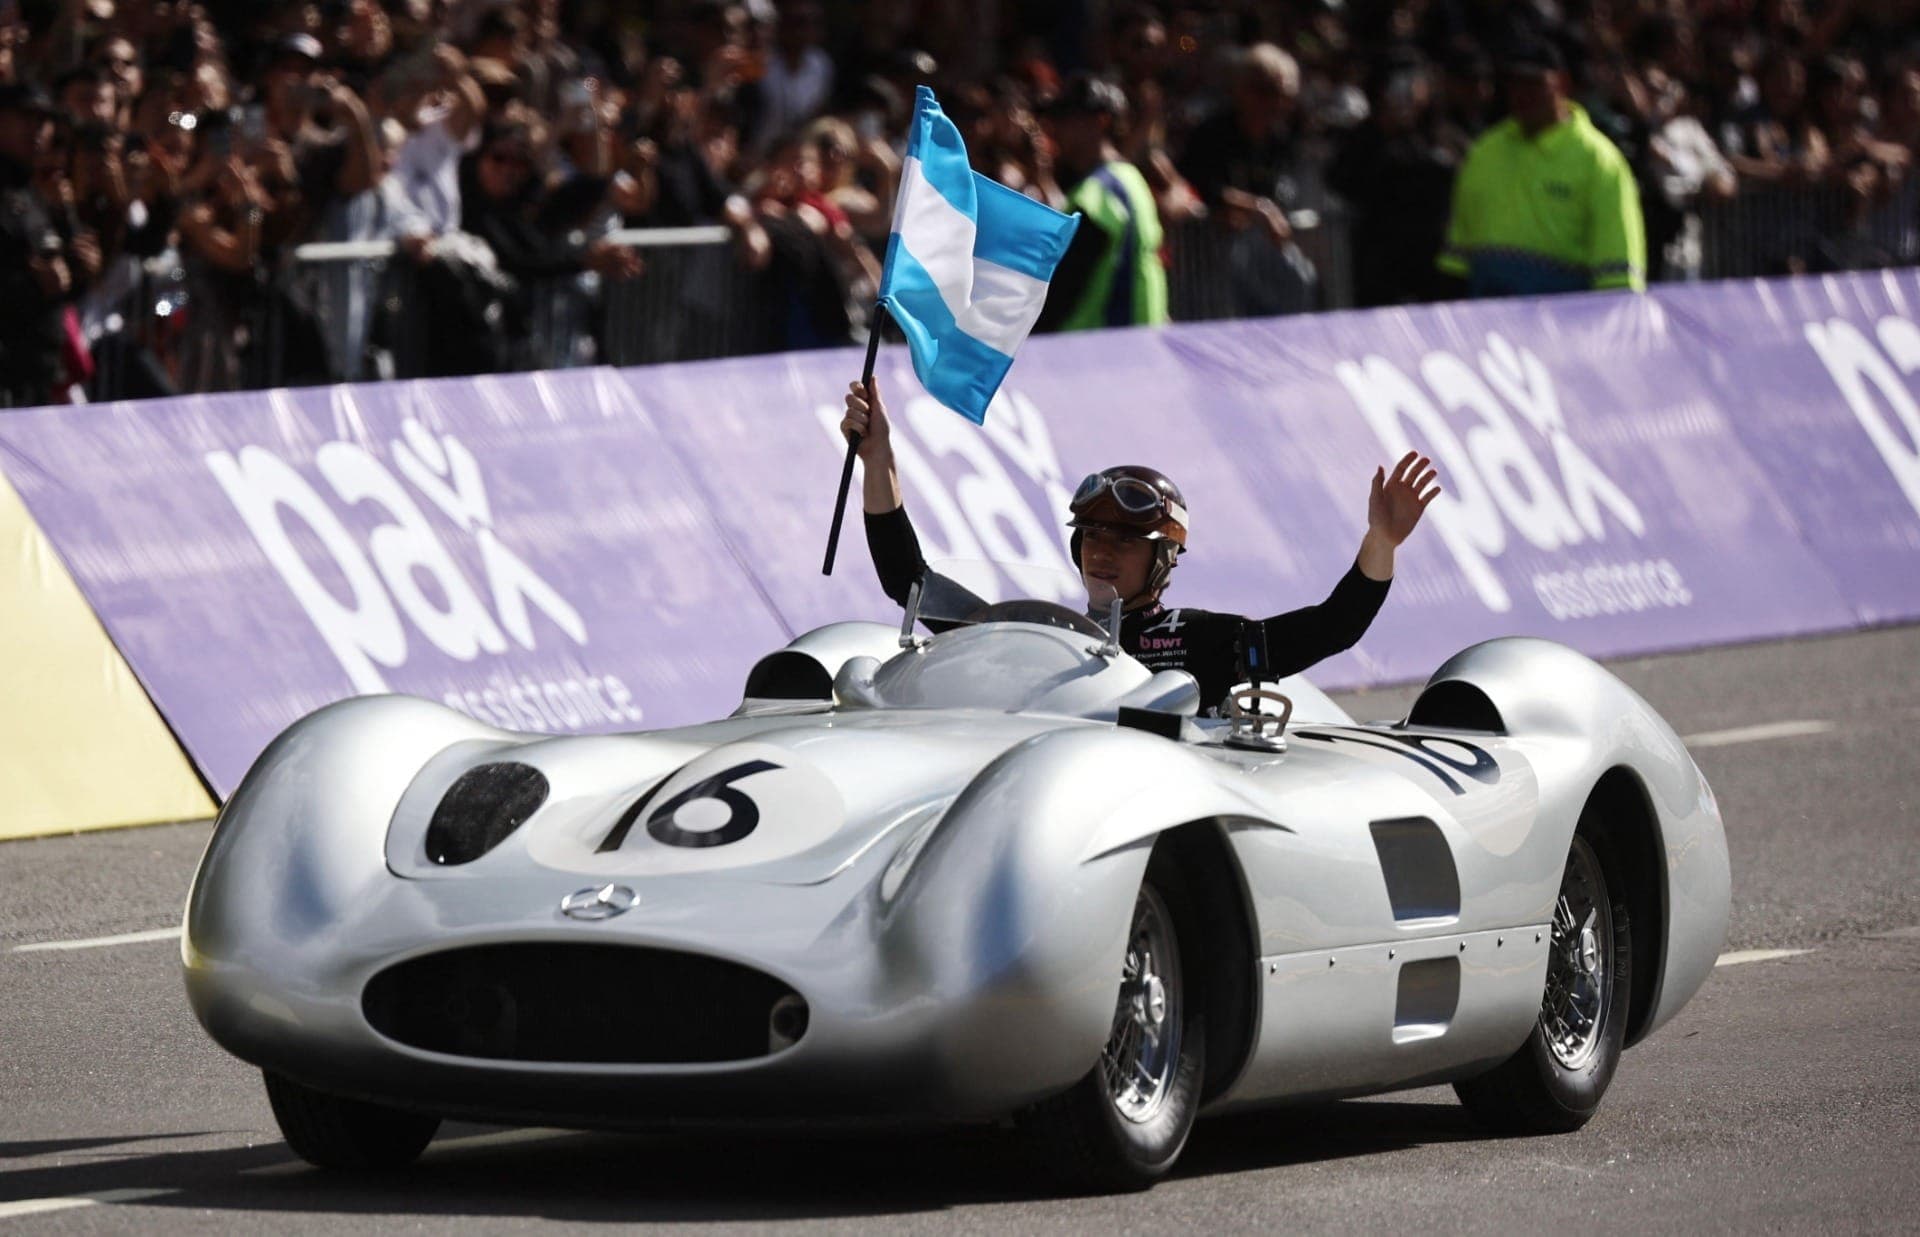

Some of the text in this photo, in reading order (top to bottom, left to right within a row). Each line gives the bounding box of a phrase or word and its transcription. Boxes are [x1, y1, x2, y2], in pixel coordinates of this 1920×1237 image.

[205, 417, 588, 694] pax
[1337, 333, 1644, 612] pax
[1153, 638, 1182, 648] BWT
[594, 759, 785, 854] 16
